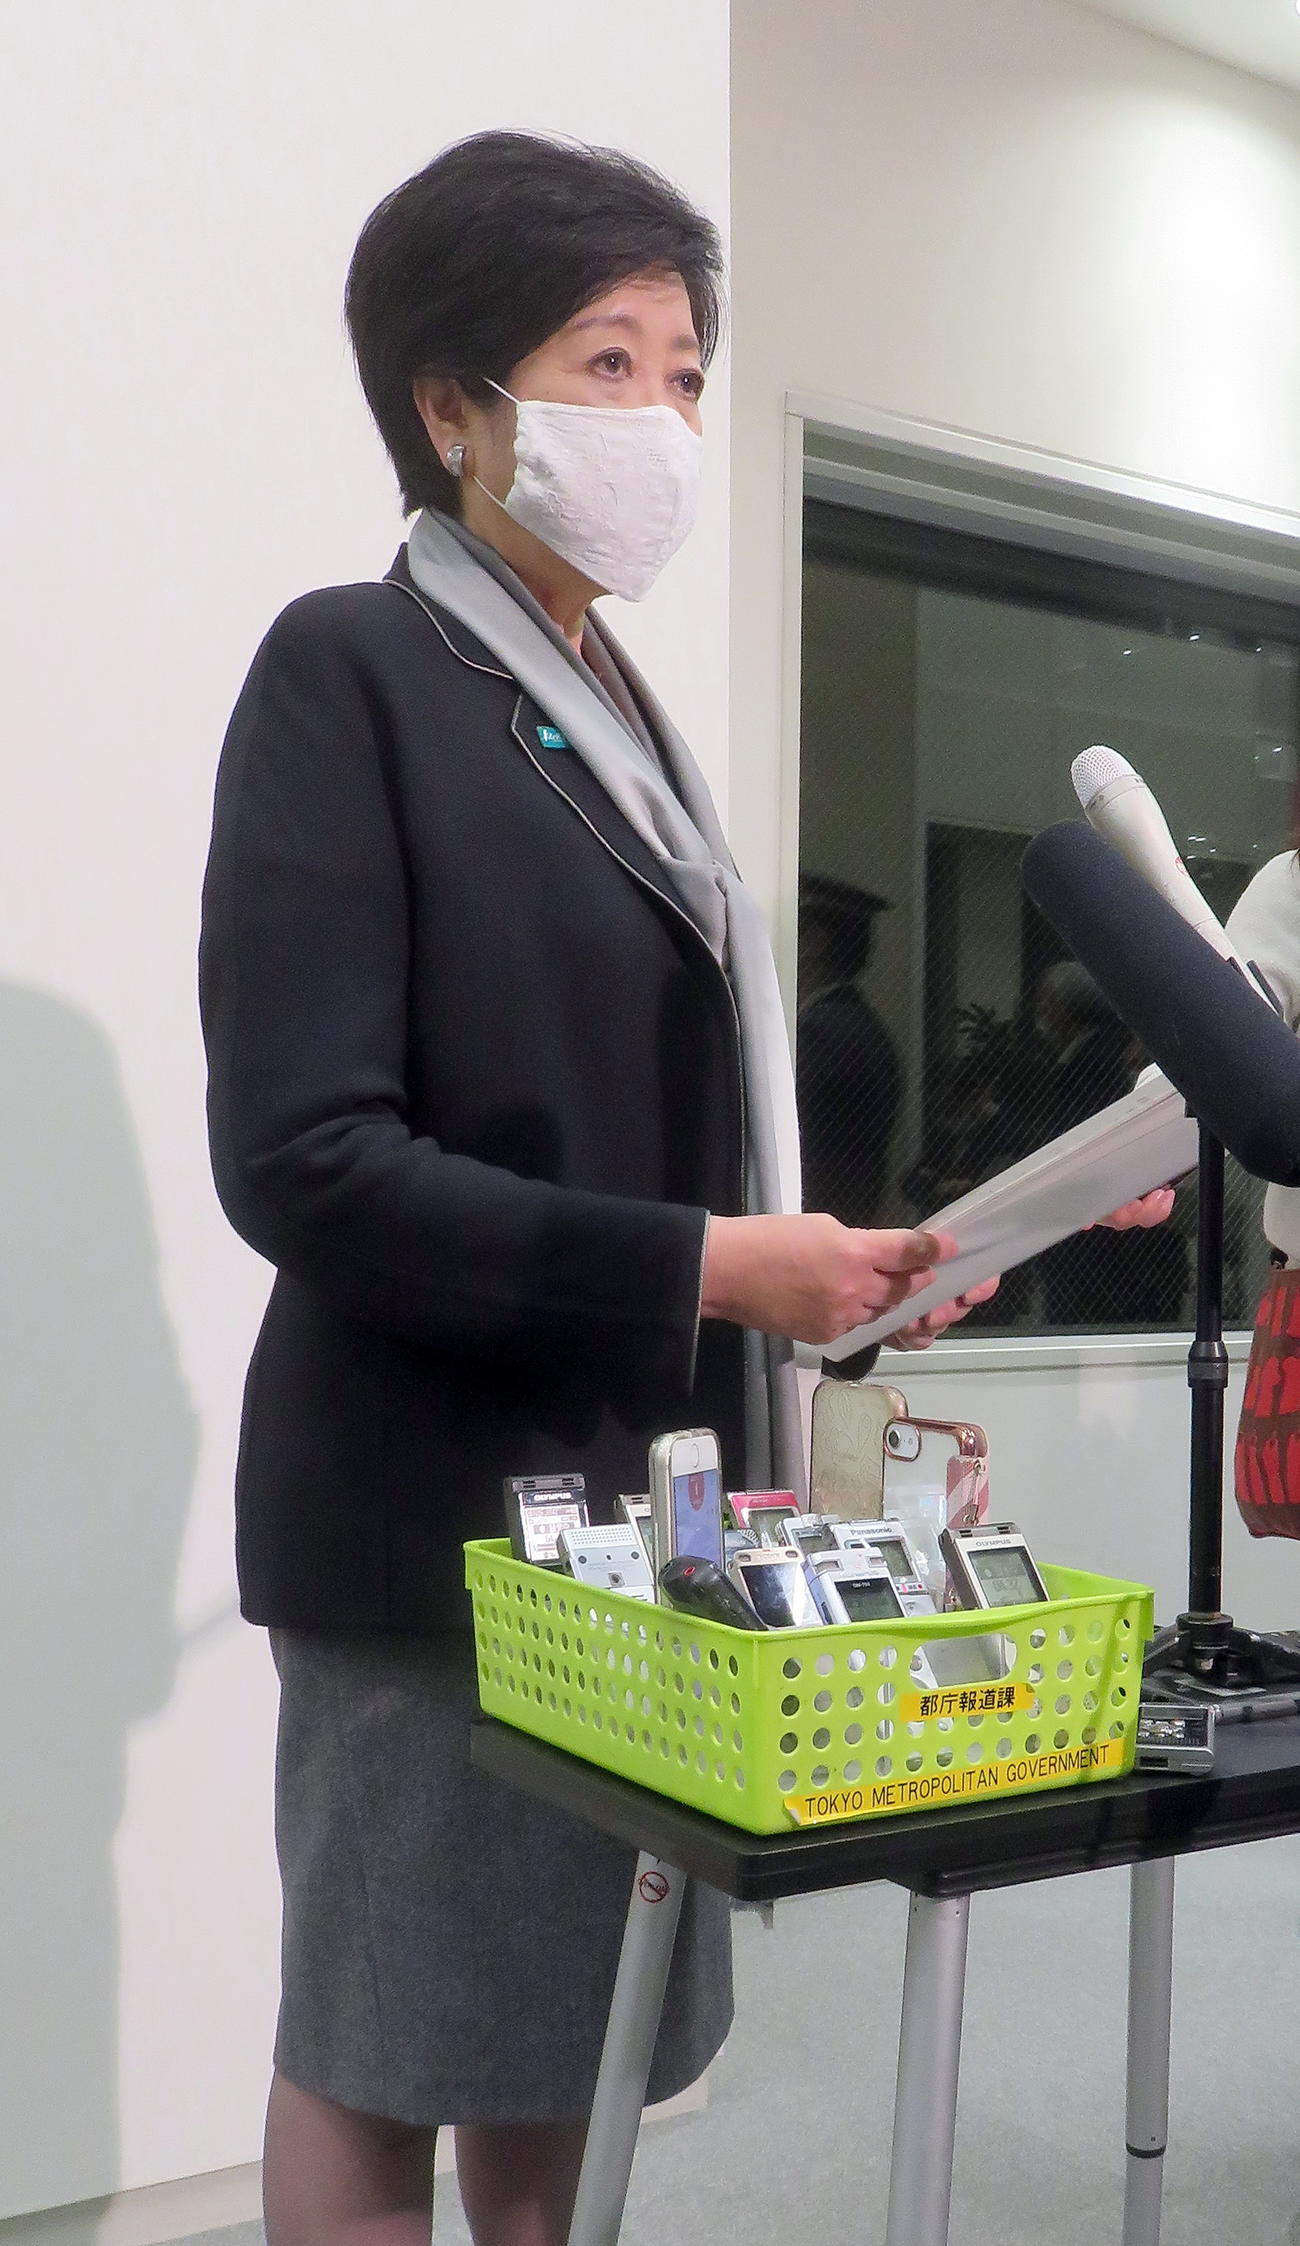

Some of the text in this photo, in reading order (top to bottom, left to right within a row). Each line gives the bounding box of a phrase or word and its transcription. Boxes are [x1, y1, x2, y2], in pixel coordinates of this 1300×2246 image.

[850, 1527, 892, 1536] Panasonic
[975, 1539, 1012, 1547] OLYMPUS
[920, 1686, 1016, 1717] 都庁報道課
[804, 1744, 1110, 1818] TOKYO METROPOLITAN GOVERNMENT
